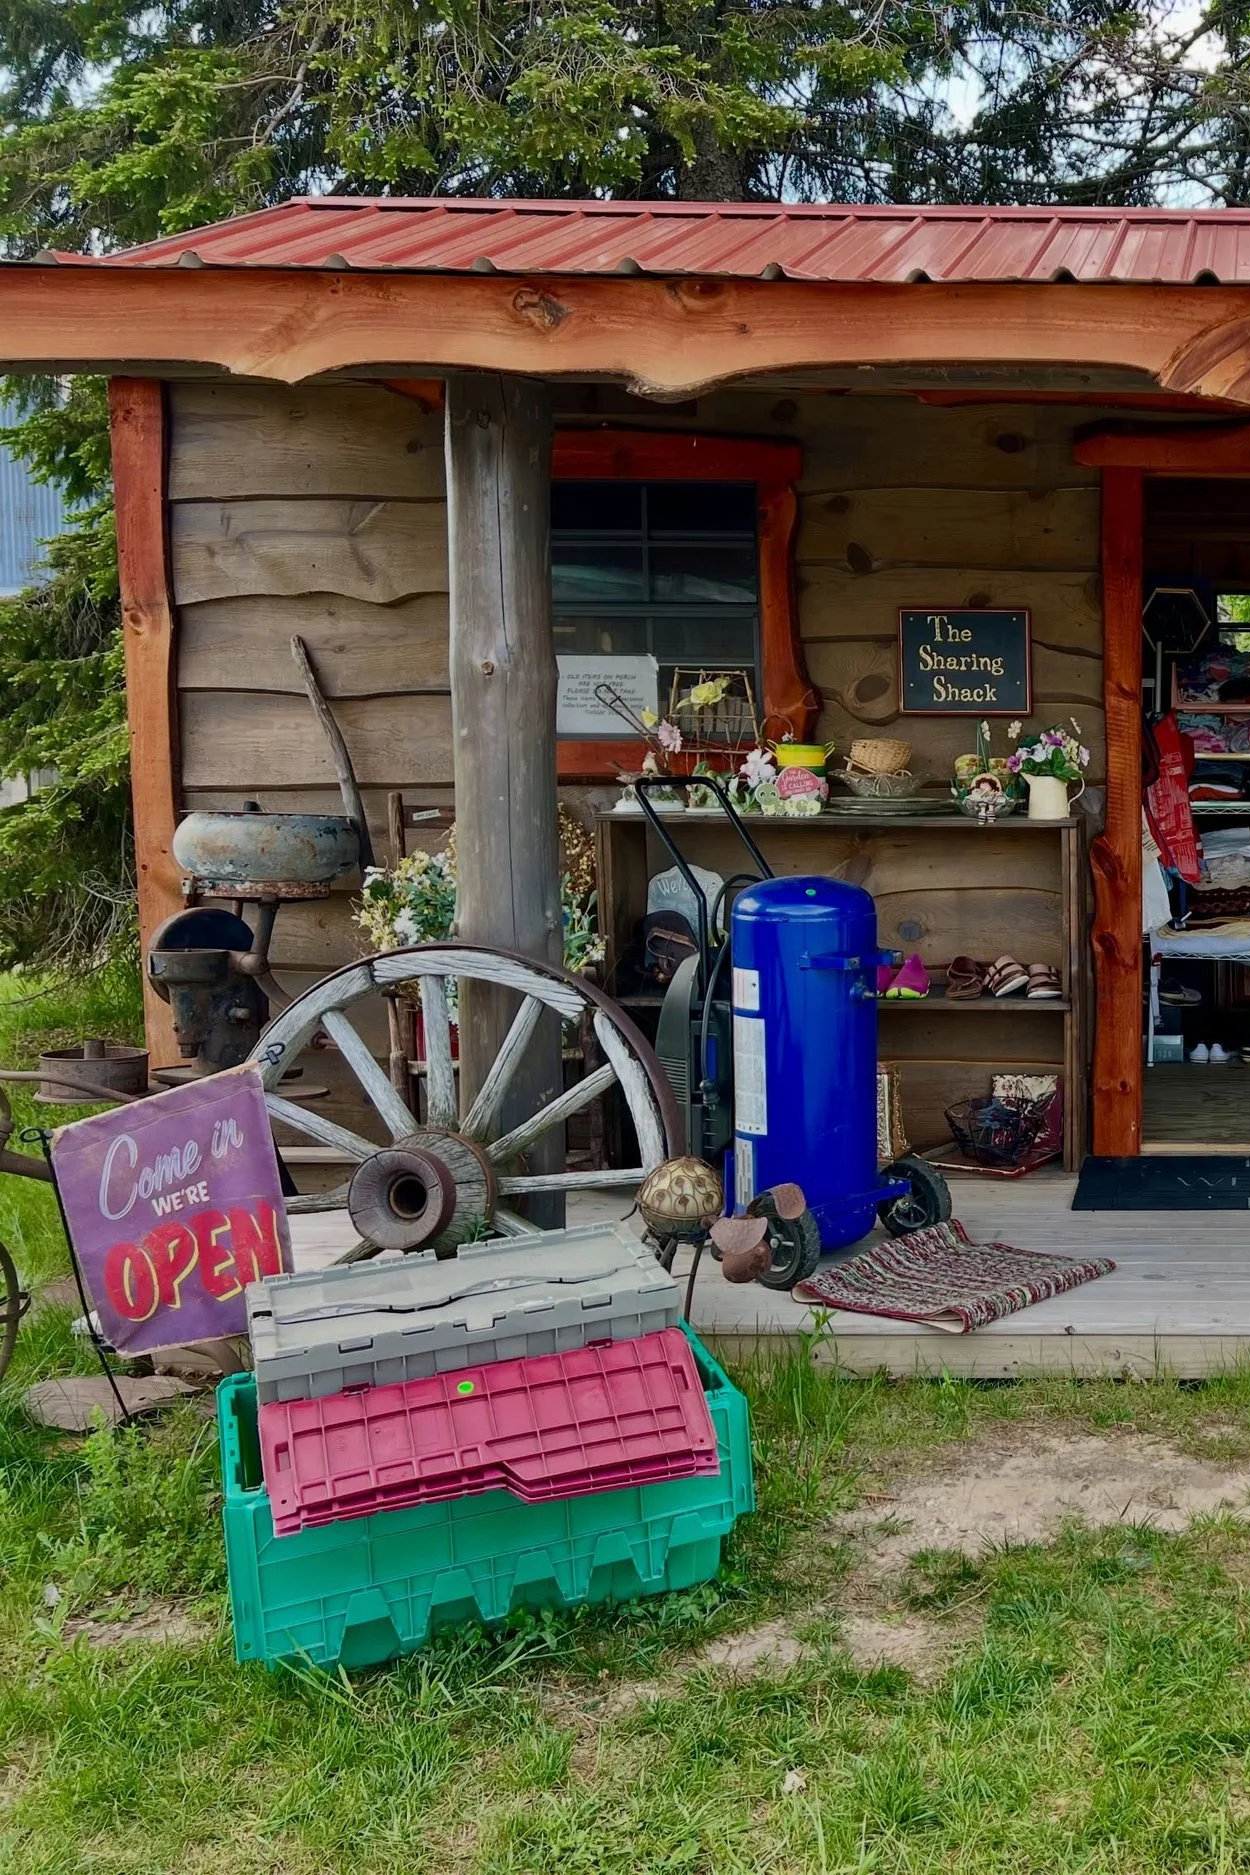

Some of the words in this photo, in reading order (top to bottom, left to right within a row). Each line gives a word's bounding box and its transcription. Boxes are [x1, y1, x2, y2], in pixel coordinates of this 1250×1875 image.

[927, 615, 972, 642] The
[919, 644, 1005, 675] Sharing
[933, 675, 998, 702] Shack
[99, 1133, 202, 1220] Come
[211, 1117, 243, 1159] in
[151, 1180, 210, 1217] WE'RE
[104, 1200, 283, 1323] OPEN
